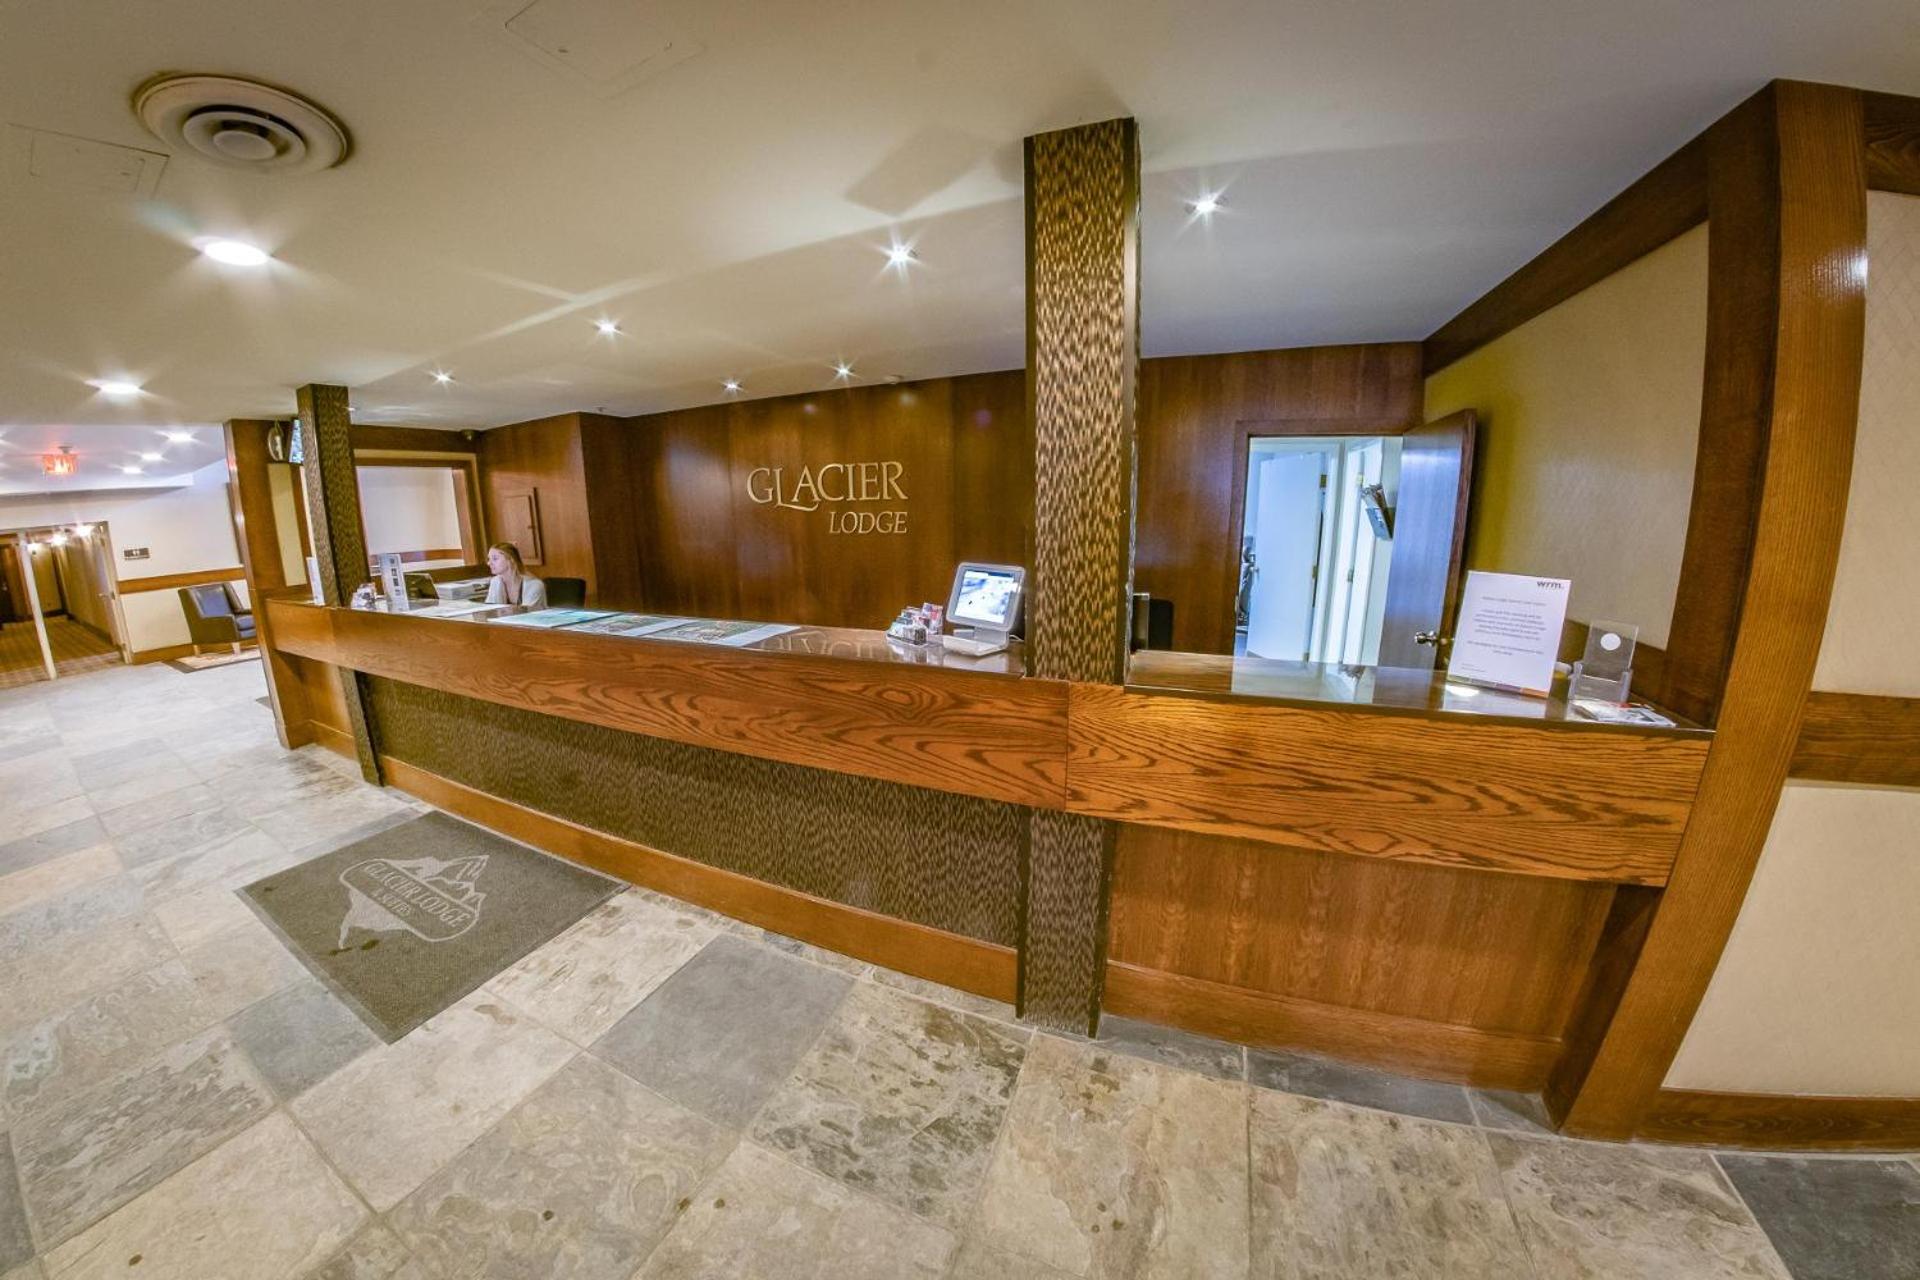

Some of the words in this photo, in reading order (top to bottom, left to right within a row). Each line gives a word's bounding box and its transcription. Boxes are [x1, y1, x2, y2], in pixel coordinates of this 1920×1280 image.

[747, 461, 908, 512] GLACIER
[829, 511, 908, 534] LODGE
[364, 862, 421, 902] GLACIER
[413, 891, 471, 927] LODGE
